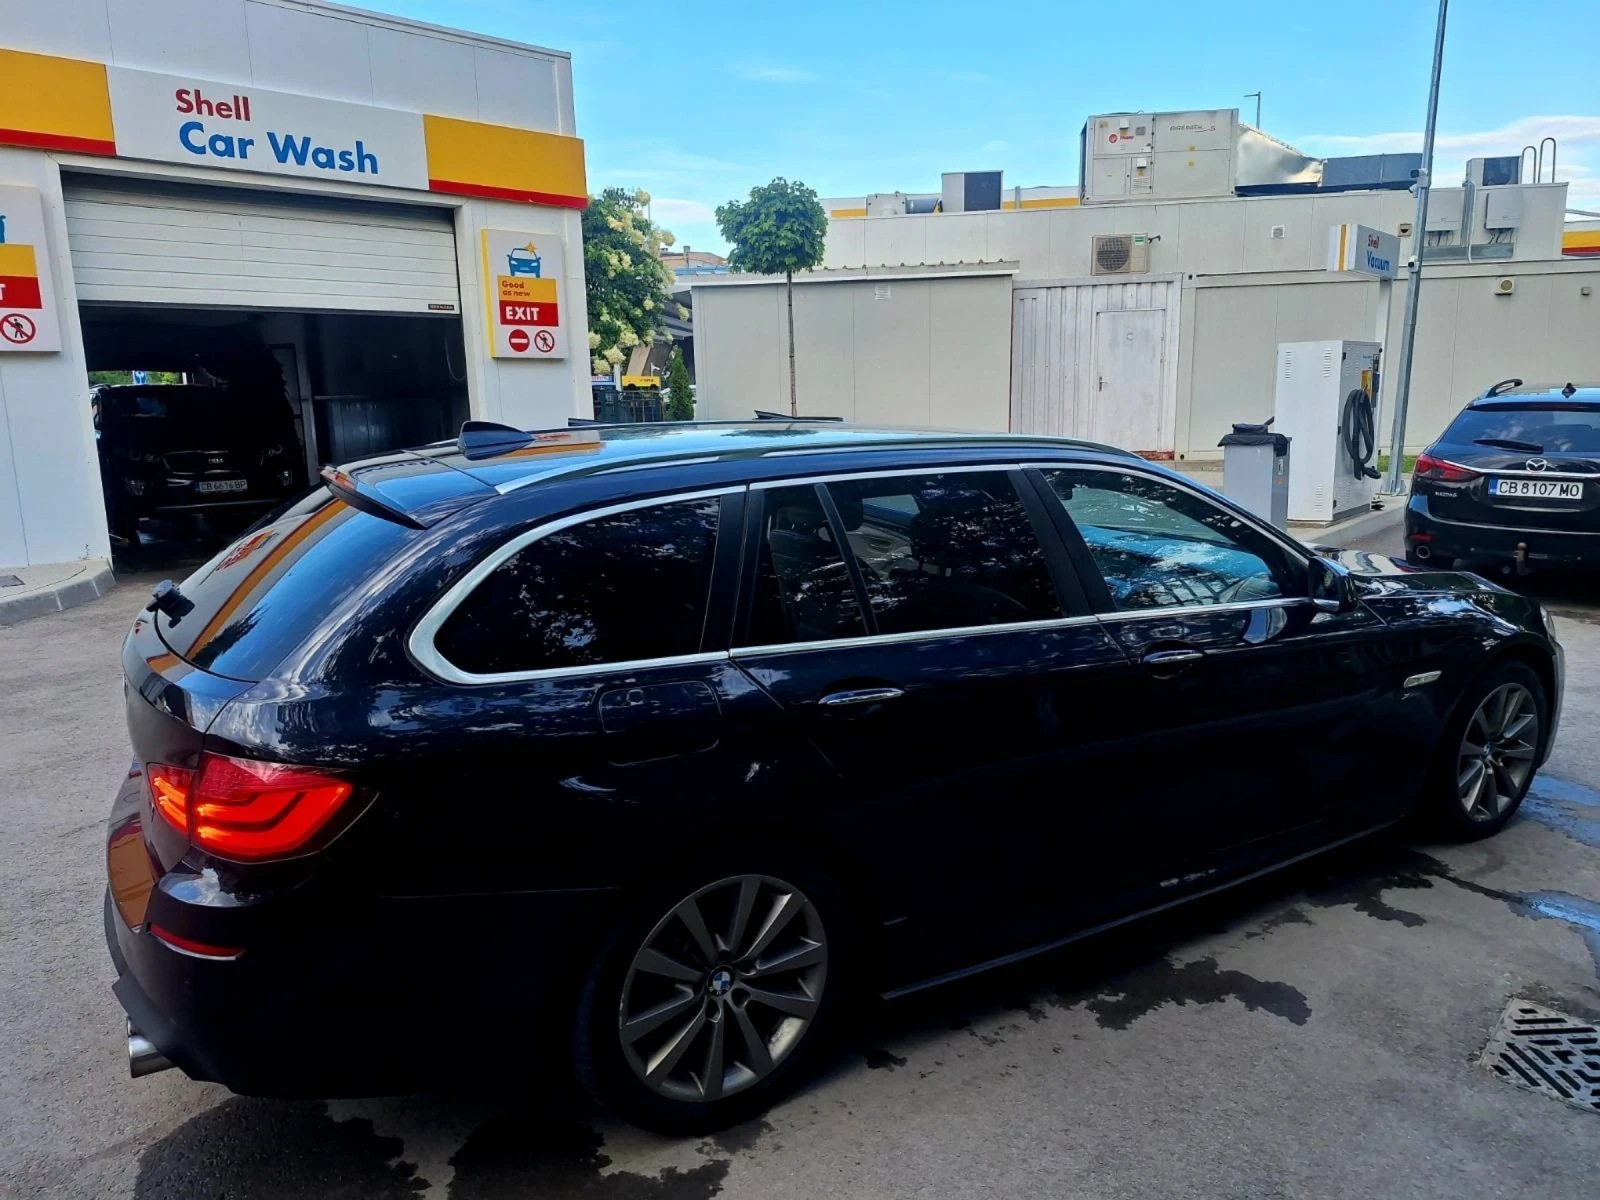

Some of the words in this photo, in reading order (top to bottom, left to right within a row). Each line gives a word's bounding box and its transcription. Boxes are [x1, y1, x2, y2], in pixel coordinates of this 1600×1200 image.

[175, 88, 251, 122] Shell
[179, 121, 255, 160] Car
[266, 131, 379, 175] Wash
[501, 280, 525, 289] Good
[505, 305, 540, 321] EXIT
[1499, 481, 1518, 494] CB
[1520, 482, 1557, 496] 8107
[1559, 483, 1580, 497] MO
